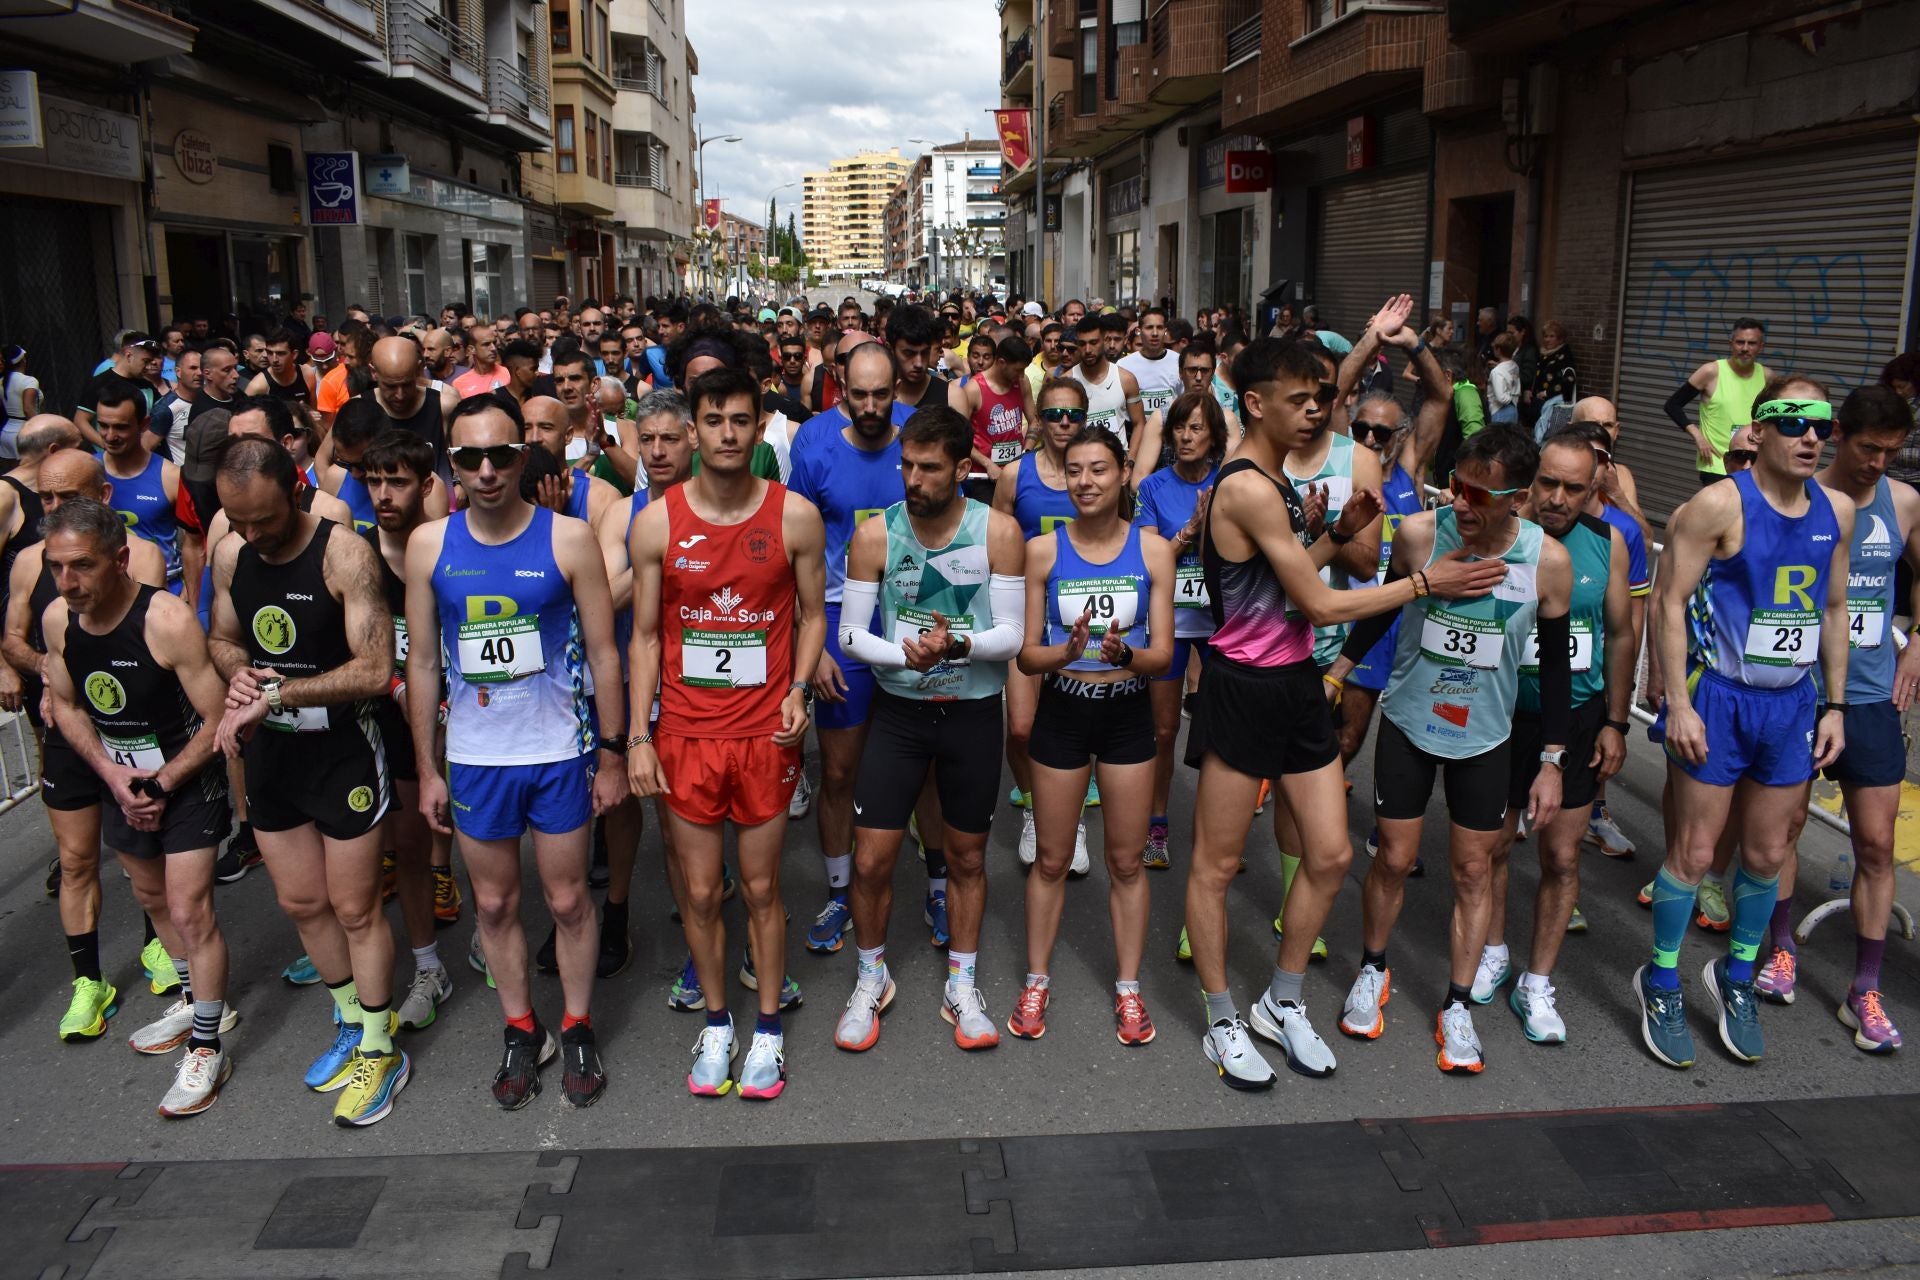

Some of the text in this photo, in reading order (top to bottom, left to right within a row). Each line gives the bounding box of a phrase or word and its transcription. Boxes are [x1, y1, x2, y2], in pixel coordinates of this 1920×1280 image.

[1272, 307, 1280, 319] P
[1147, 398, 1166, 409] 105
[998, 447, 1016, 459] 234
[1873, 550, 1891, 558] Rioja
[1183, 579, 1205, 598] 47
[1773, 565, 1817, 612] R
[1847, 572, 1887, 587] hiruc
[680, 606, 712, 623] Caja
[738, 608, 775, 623] Soria
[1083, 594, 1115, 619] 49
[461, 618, 527, 632] XV CARRERA POPULAR
[914, 612, 933, 621] CARRER
[1442, 612, 1468, 624] CARRERA
[1469, 618, 1496, 627] POPULAR
[1849, 613, 1864, 635] 4
[1443, 629, 1477, 654] 33
[1772, 627, 1803, 652] 23
[480, 637, 515, 665] 40
[715, 649, 732, 673] 2
[1053, 674, 1148, 699] NIKE PRO
[115, 750, 137, 768] 41
